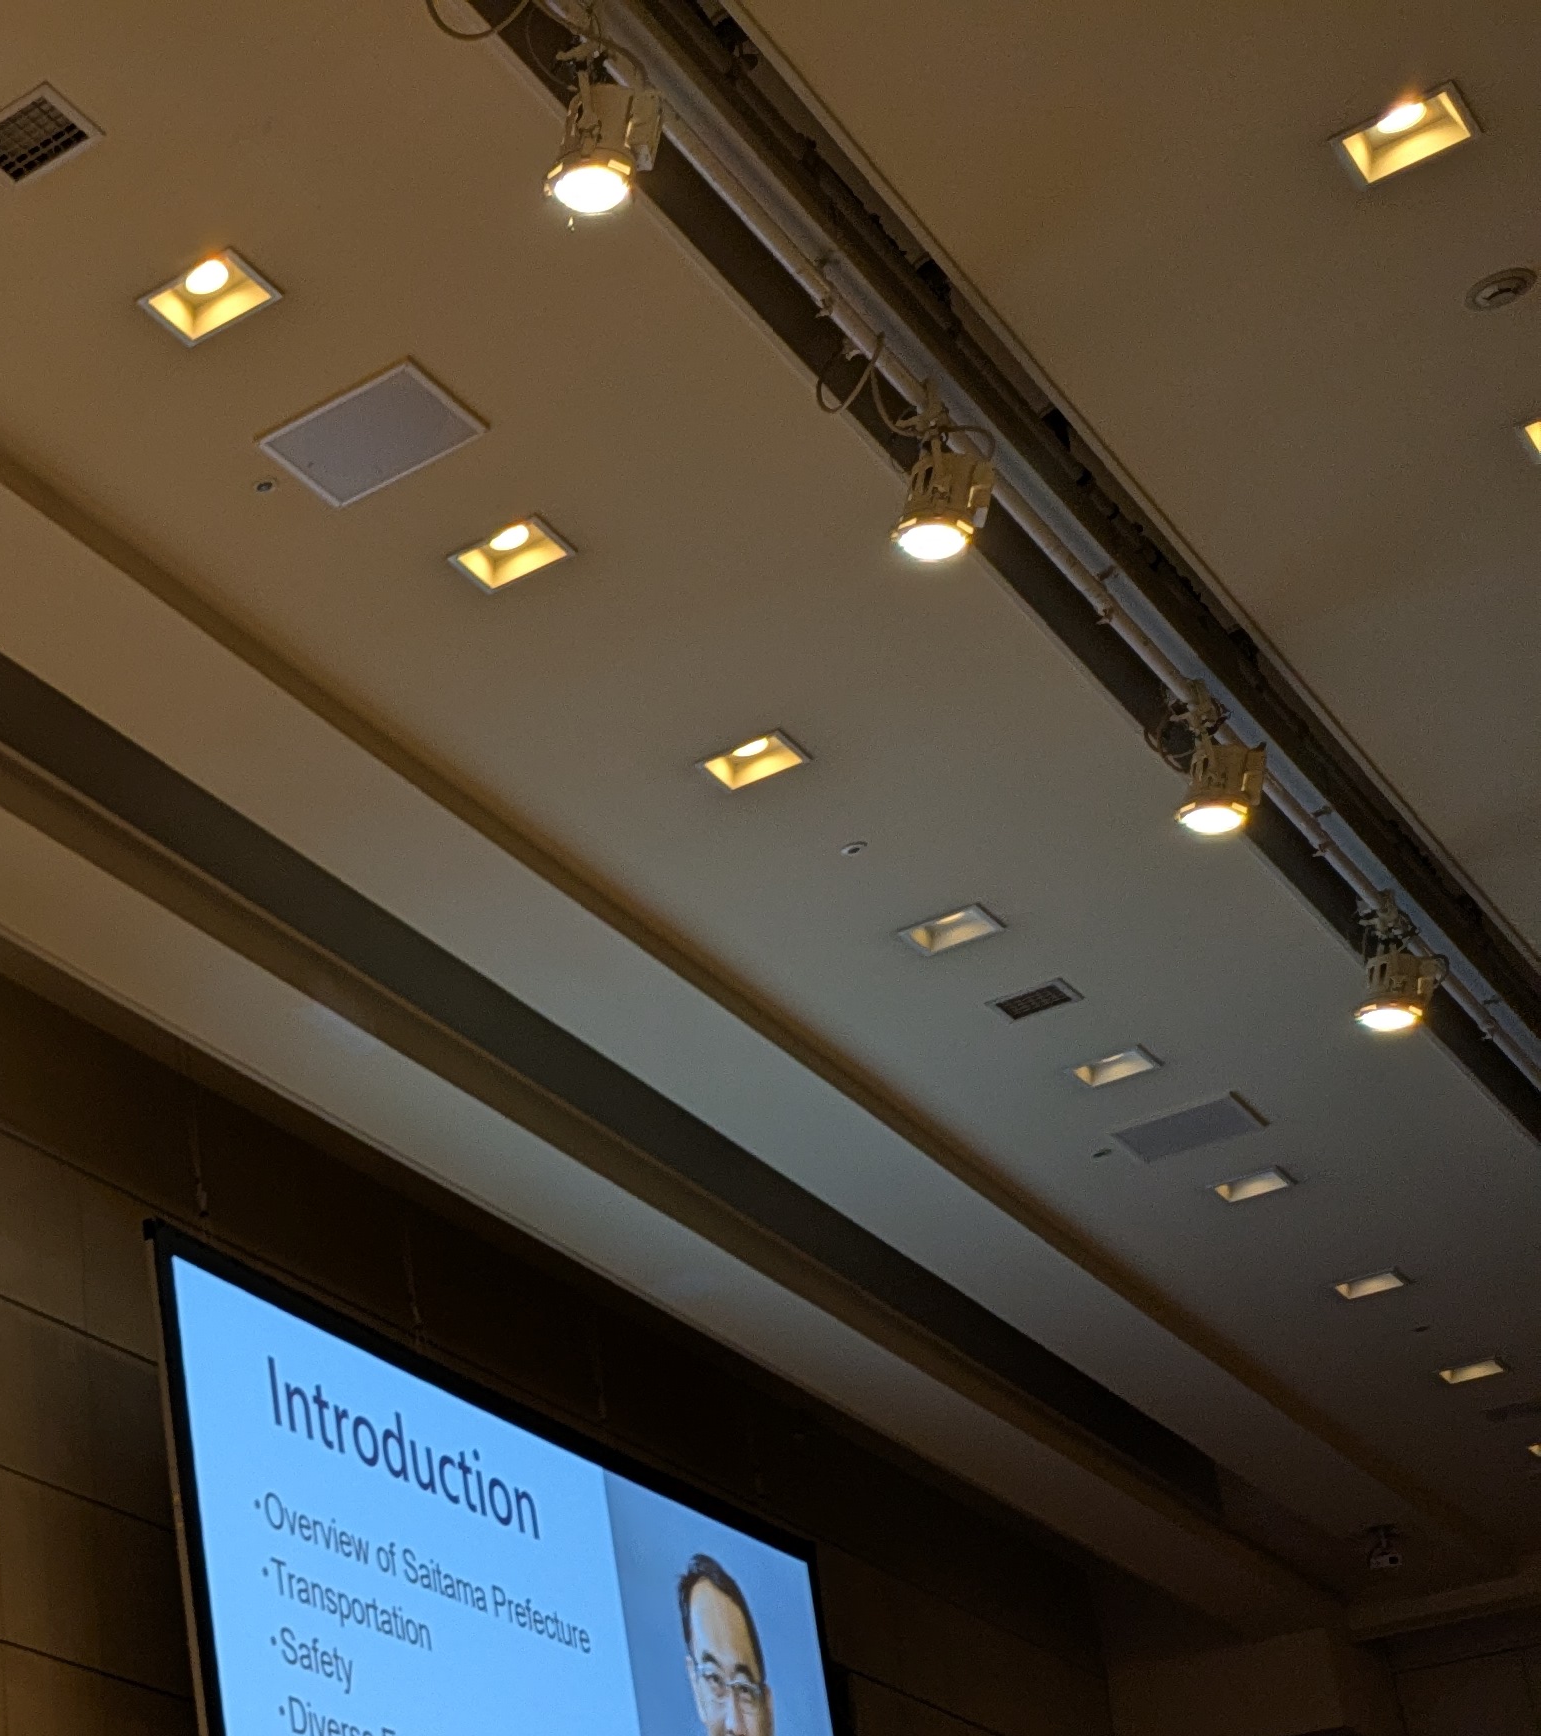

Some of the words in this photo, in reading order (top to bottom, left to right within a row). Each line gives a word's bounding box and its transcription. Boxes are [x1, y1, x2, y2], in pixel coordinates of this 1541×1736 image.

[267, 1355, 540, 1540] Introduction
[264, 1491, 369, 1565] Overview
[376, 1542, 397, 1576] of
[402, 1548, 488, 1612] Saitama
[492, 1585, 592, 1653] Prefecture
[270, 1557, 433, 1650] Transportation
[280, 1626, 353, 1694] Safety
